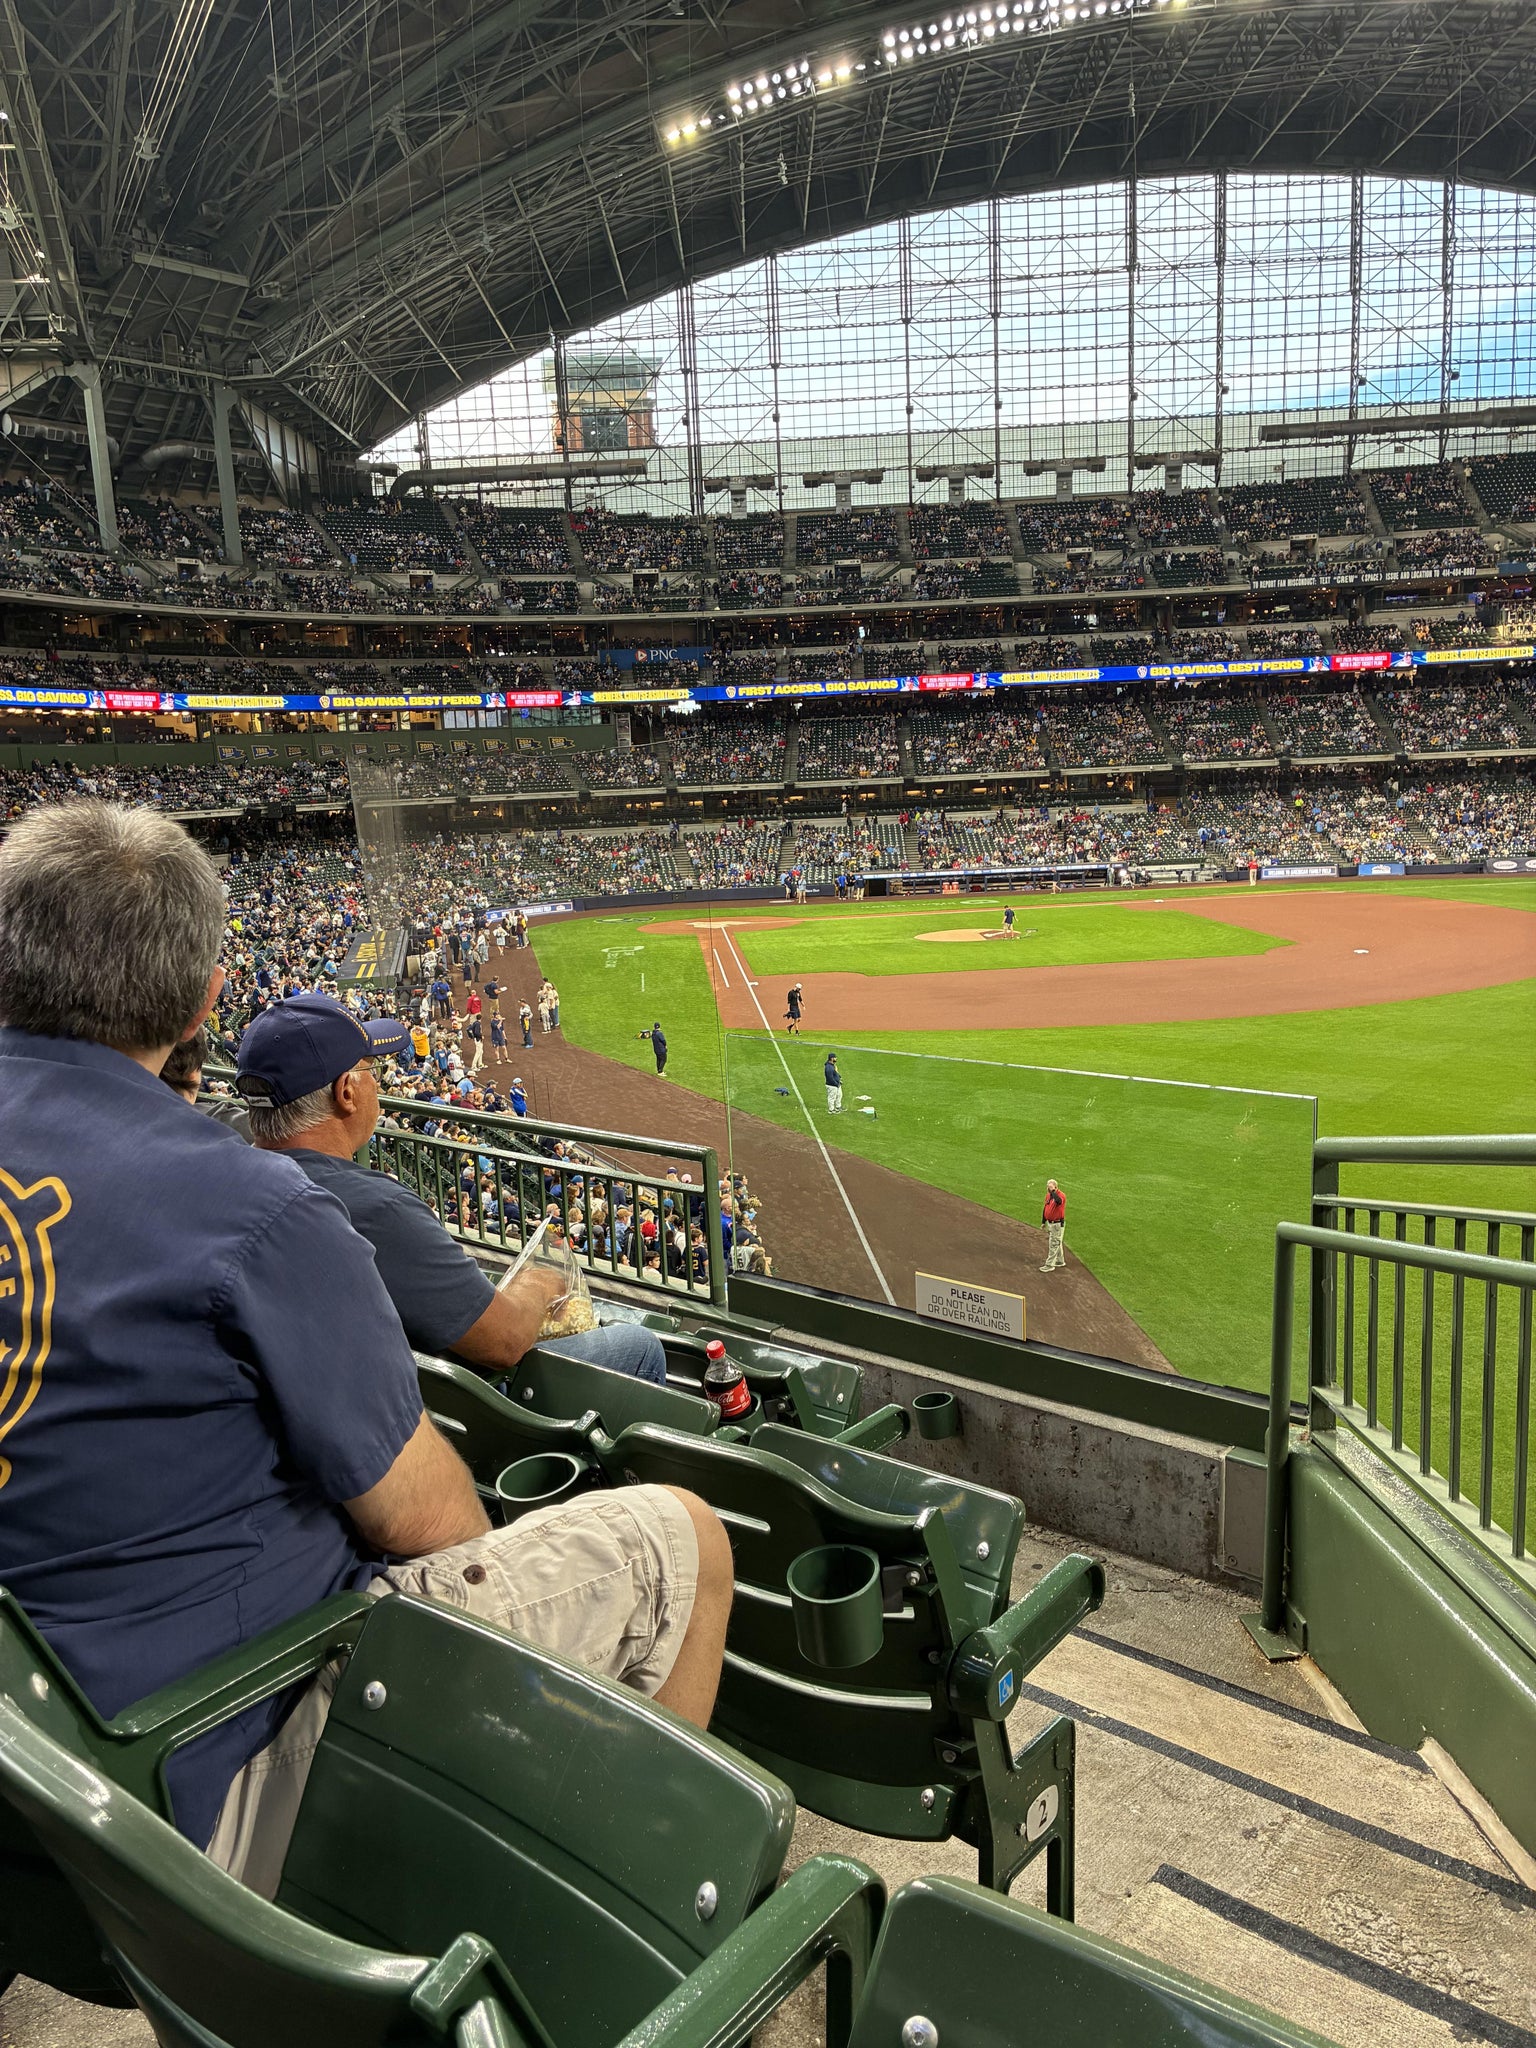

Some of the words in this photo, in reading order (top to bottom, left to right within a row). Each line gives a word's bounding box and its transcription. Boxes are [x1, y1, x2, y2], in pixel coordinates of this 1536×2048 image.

[1253, 581, 1259, 589] TO
[1259, 580, 1277, 589] REPORT
[1277, 579, 1287, 587] FAN
[1287, 577, 1317, 587] MISCONDUCT:
[1319, 576, 1331, 585] TEXT
[1333, 575, 1358, 584] "CREW"
[1361, 572, 1382, 582] (SPACE)
[1385, 572, 1399, 581] ISSUE
[1400, 571, 1410, 580] AND
[1410, 569, 1432, 579] LOCATION
[1433, 569, 1440, 578] TO
[650, 648, 678, 661] PNC
[1150, 666, 1171, 677] BIG
[1172, 664, 1227, 676] SAVINGS.
[1228, 662, 1262, 673] BEST
[1262, 660, 1304, 671] PERKS
[16, 690, 35, 702] BIG
[36, 691, 87, 704] SAVINGS
[738, 685, 773, 697] FIRST
[774, 684, 825, 695] ACCESS.
[826, 682, 847, 692] BIG
[847, 680, 898, 691] SAVINGS
[333, 697, 354, 707] BIG
[355, 696, 409, 707] SAVINGS.
[409, 696, 441, 706] BEST
[442, 695, 482, 706] PERKS
[950, 1288, 986, 1304] PLEASE
[931, 1294, 944, 1306] DO
[946, 1298, 964, 1310] NOT
[965, 1302, 990, 1316] LEAN
[992, 1308, 1006, 1321] ON
[927, 1303, 940, 1314] OR
[942, 1306, 966, 1321] OVER
[967, 1313, 1011, 1332] RAILINGS
[1038, 1799, 1048, 1828] 2
